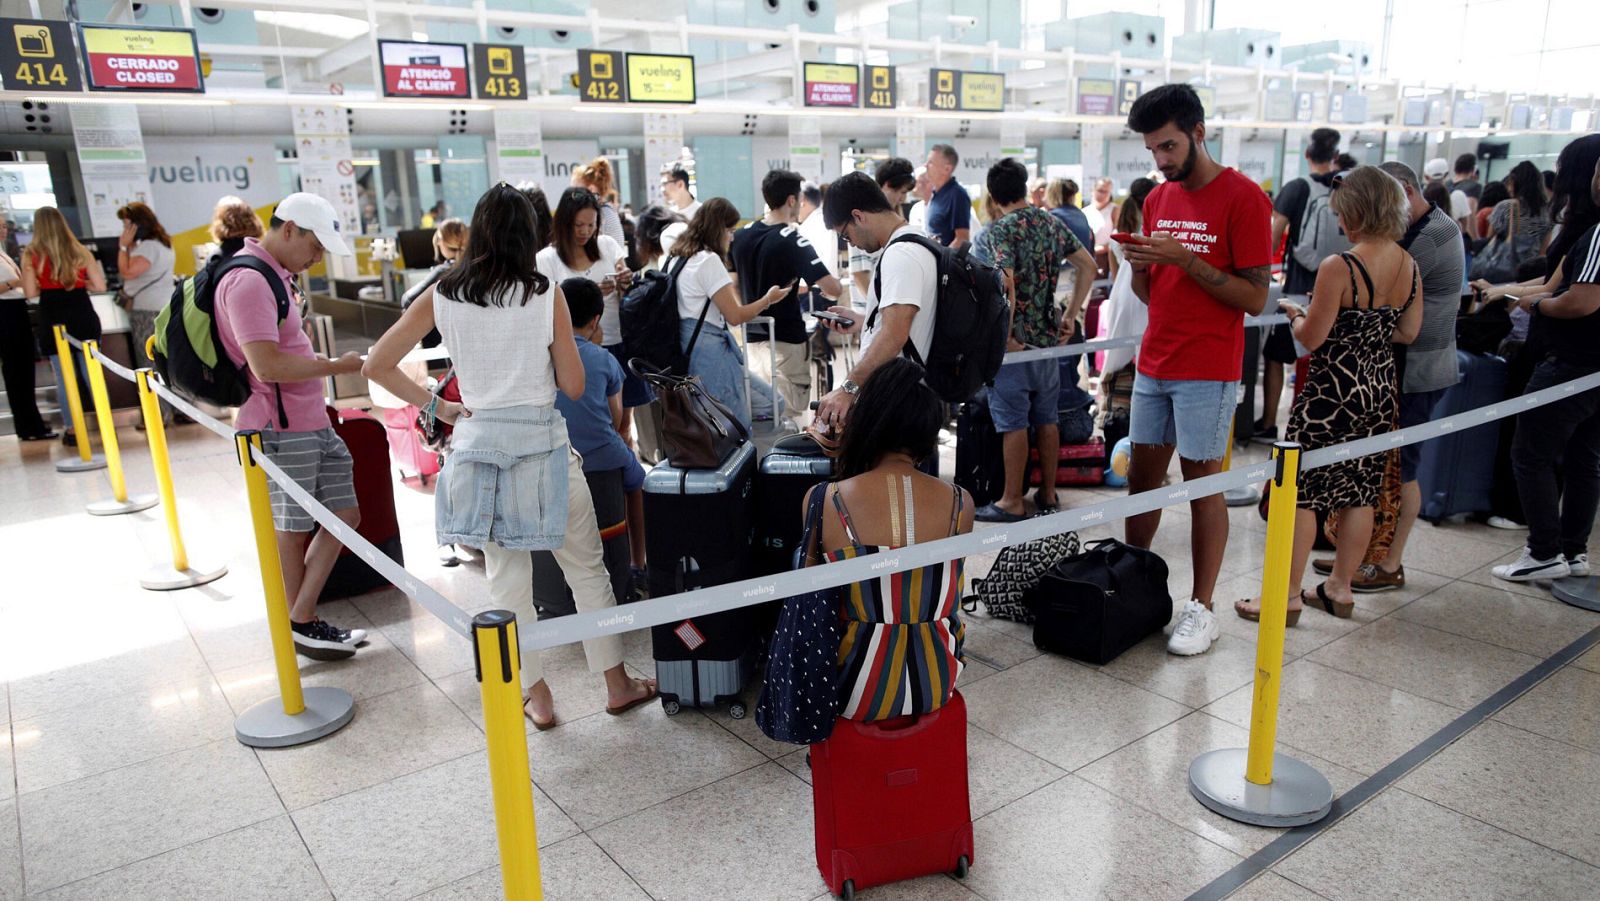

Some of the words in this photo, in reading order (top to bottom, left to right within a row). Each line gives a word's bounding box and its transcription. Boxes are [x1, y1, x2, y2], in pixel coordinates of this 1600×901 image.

[107, 57, 180, 71] CERRADO
[15, 62, 68, 86] 414
[116, 71, 176, 84] CLOSED
[400, 67, 451, 80] ATENCIÓ
[640, 64, 681, 81] vueling
[397, 80, 413, 90] AL
[415, 80, 456, 91] CLIENT
[485, 77, 521, 97] 413
[587, 82, 619, 99] 412
[811, 93, 821, 101] AL
[822, 93, 853, 102] CLIENTE
[870, 90, 891, 106] 411
[934, 93, 956, 109] 410
[1156, 219, 1180, 229] GREAT
[1180, 221, 1208, 231] THINGS
[1190, 232, 1217, 243] FROM
[1182, 242, 1211, 253] ONES.
[982, 534, 1007, 545] vueling
[870, 557, 899, 570] vueling
[743, 586, 775, 598] vueling
[597, 613, 635, 628] vueling
